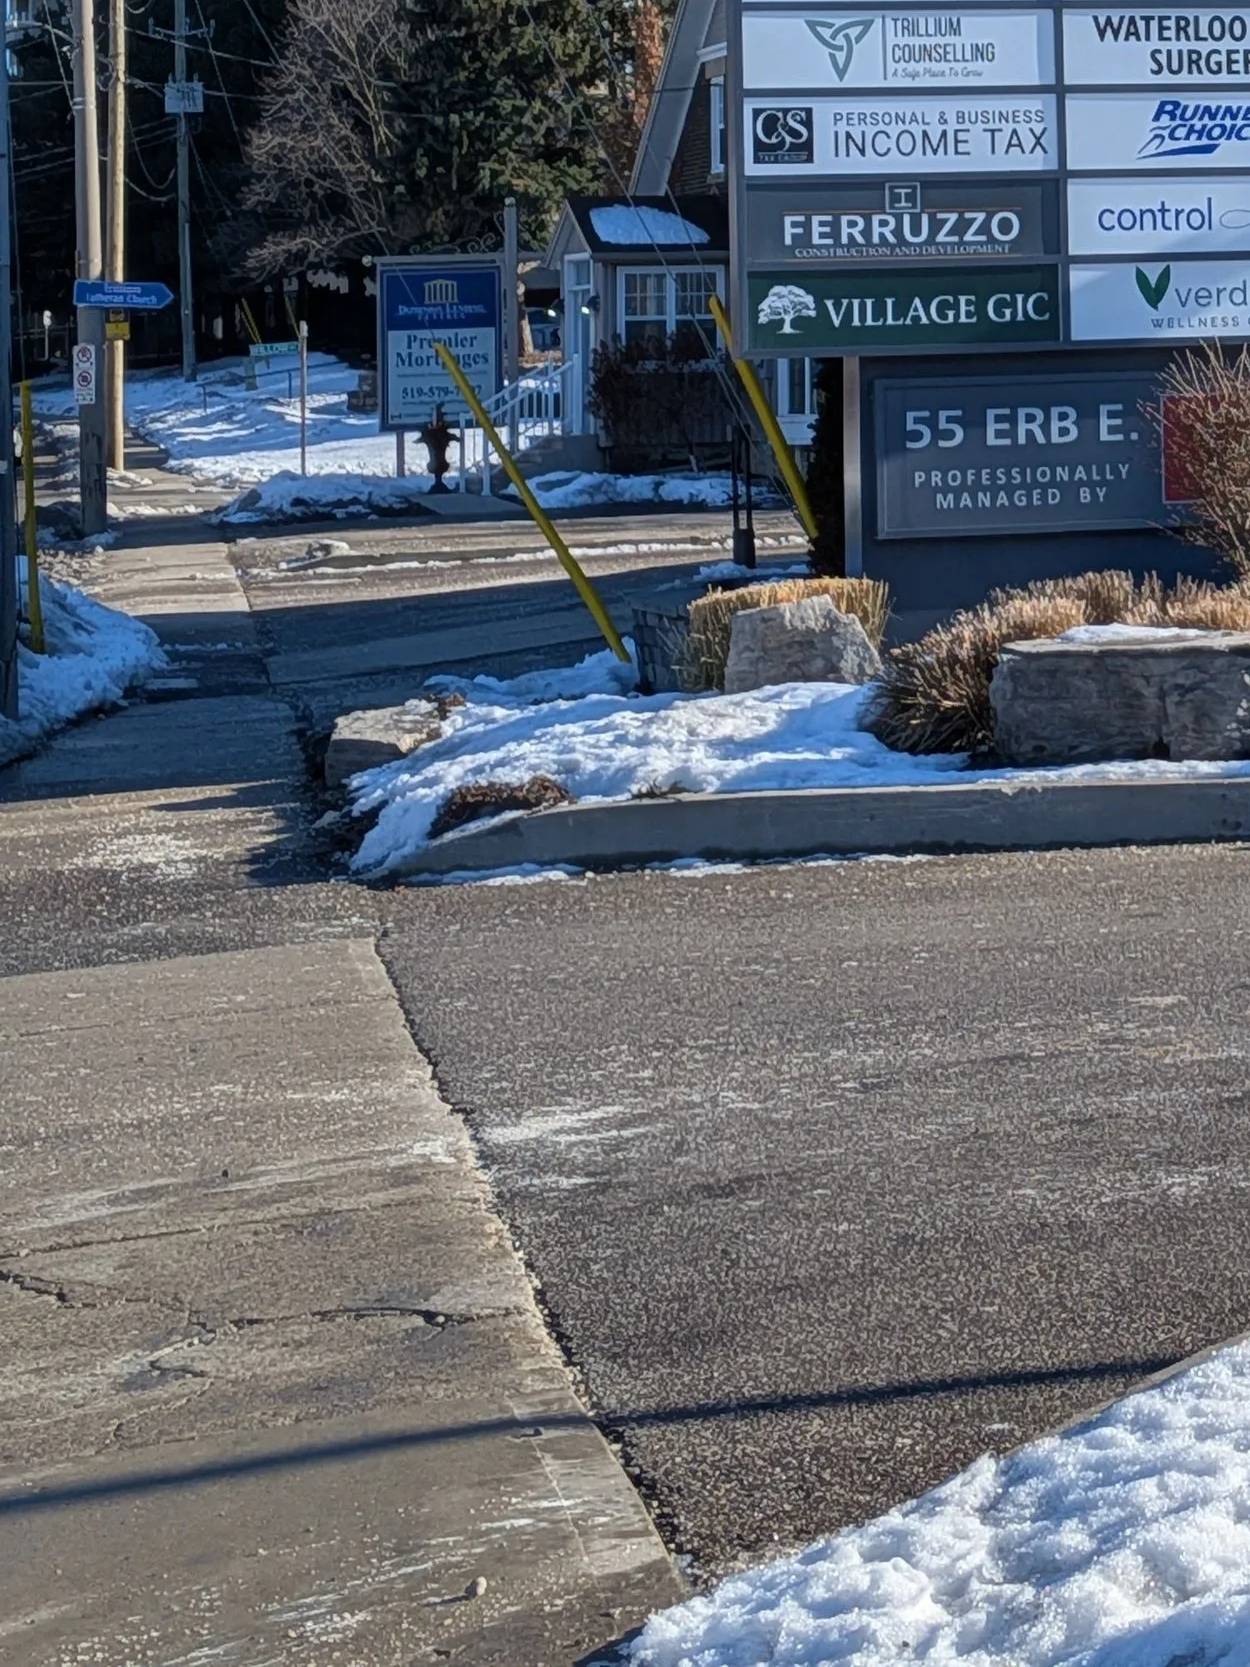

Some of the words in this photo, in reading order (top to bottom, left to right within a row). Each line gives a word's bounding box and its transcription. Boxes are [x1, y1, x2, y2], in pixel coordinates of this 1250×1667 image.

[891, 17, 962, 38] TRILLIUM
[1091, 14, 1247, 43] WATERLOO
[891, 42, 996, 64] COUNSELLING
[891, 67, 899, 78] A
[901, 66, 921, 81] Safe
[923, 66, 946, 78] Place
[948, 66, 959, 78] To
[961, 66, 983, 78] Grow
[833, 110, 930, 127] PERSONAL
[937, 110, 949, 126] &
[955, 109, 1045, 125] BUSINESS
[833, 128, 971, 158] INCOME
[982, 127, 1049, 155] TAX
[1097, 196, 1214, 232] control
[783, 211, 1021, 246] FERRUZZO
[794, 246, 892, 259] CONSTRUCTION
[893, 245, 920, 256] AND
[921, 243, 1012, 256] DEVELOPMENT
[824, 294, 977, 328] VILLAGE
[986, 292, 1050, 322] GIC
[1150, 316, 1240, 329] WELLNESS
[904, 408, 965, 450] 55
[985, 405, 1079, 446] ERB
[1099, 403, 1139, 442] E.
[914, 462, 1131, 488] PROFESSIONALLY
[935, 488, 1061, 510] MANAGED
[1079, 486, 1108, 504] BY
